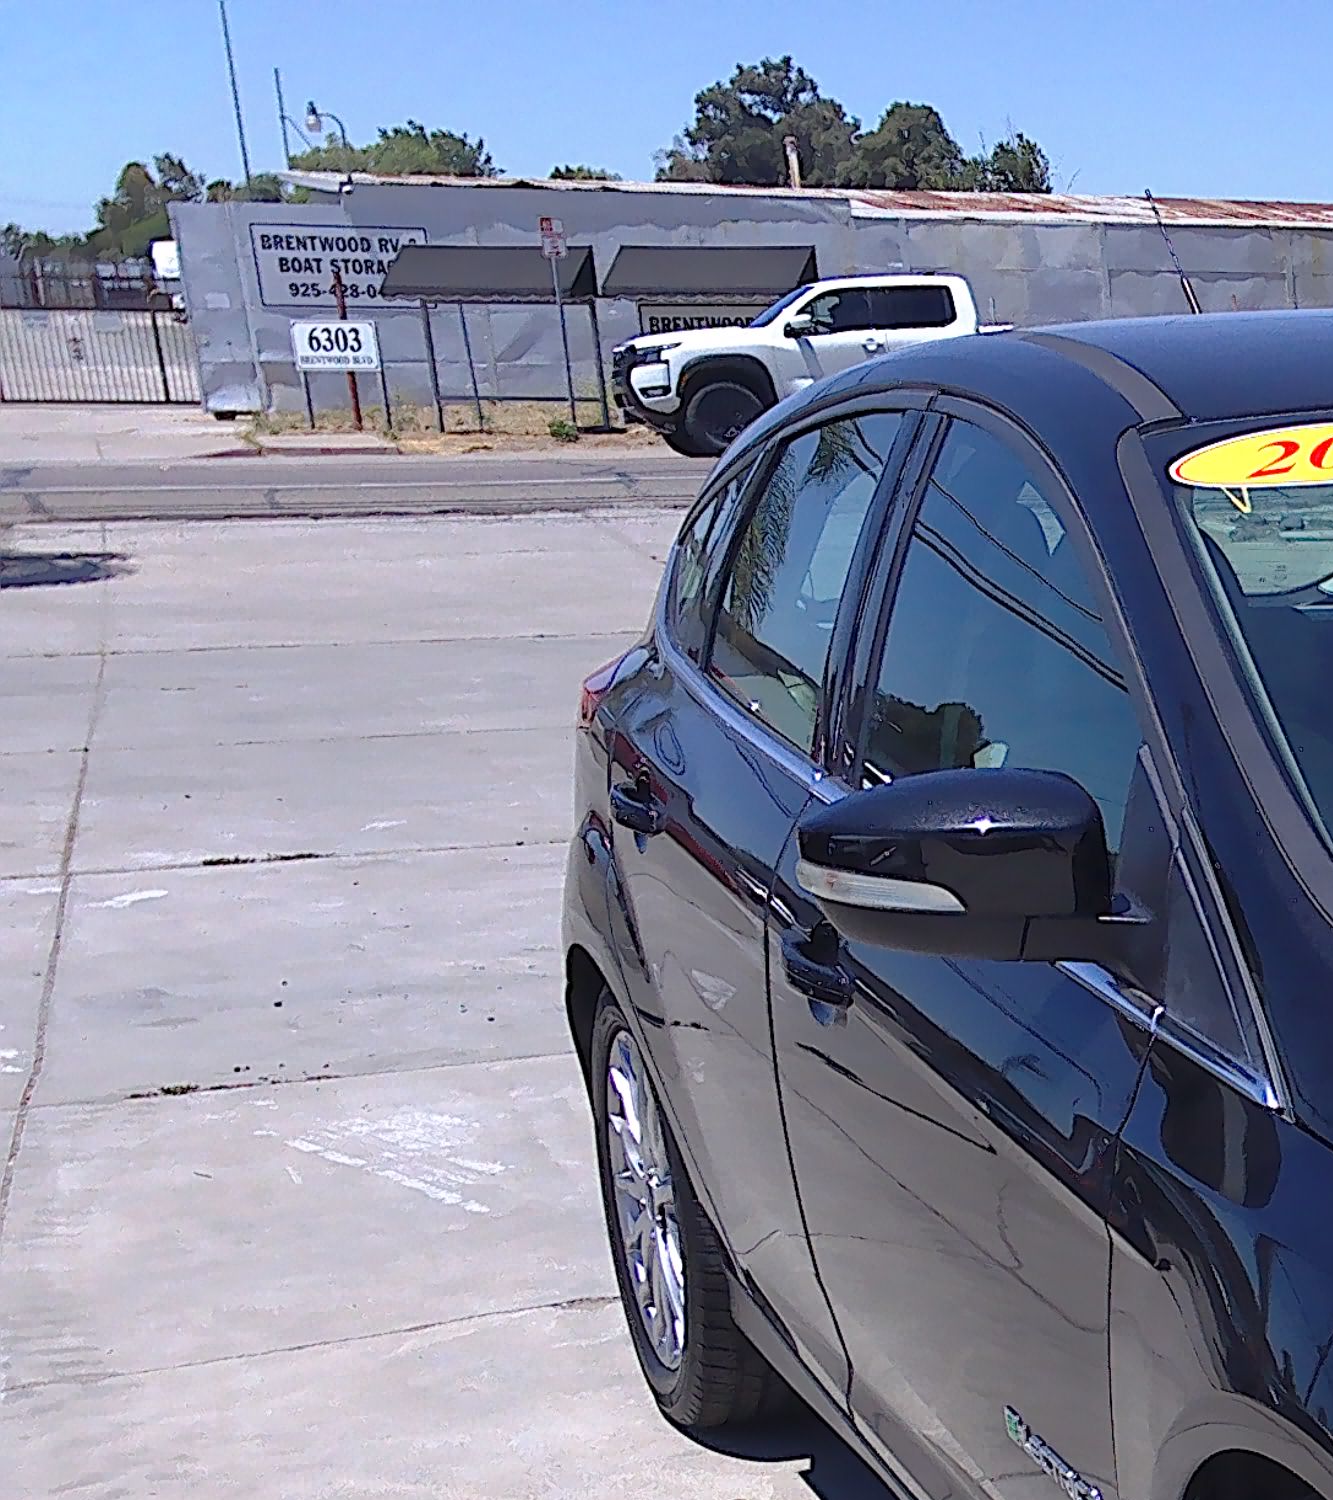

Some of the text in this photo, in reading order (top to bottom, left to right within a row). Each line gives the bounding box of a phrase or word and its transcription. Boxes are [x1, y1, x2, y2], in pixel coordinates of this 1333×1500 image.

[260, 234, 399, 253] BRENTWOOD RV
[279, 256, 323, 274] BOAT
[308, 327, 362, 353] 6303
